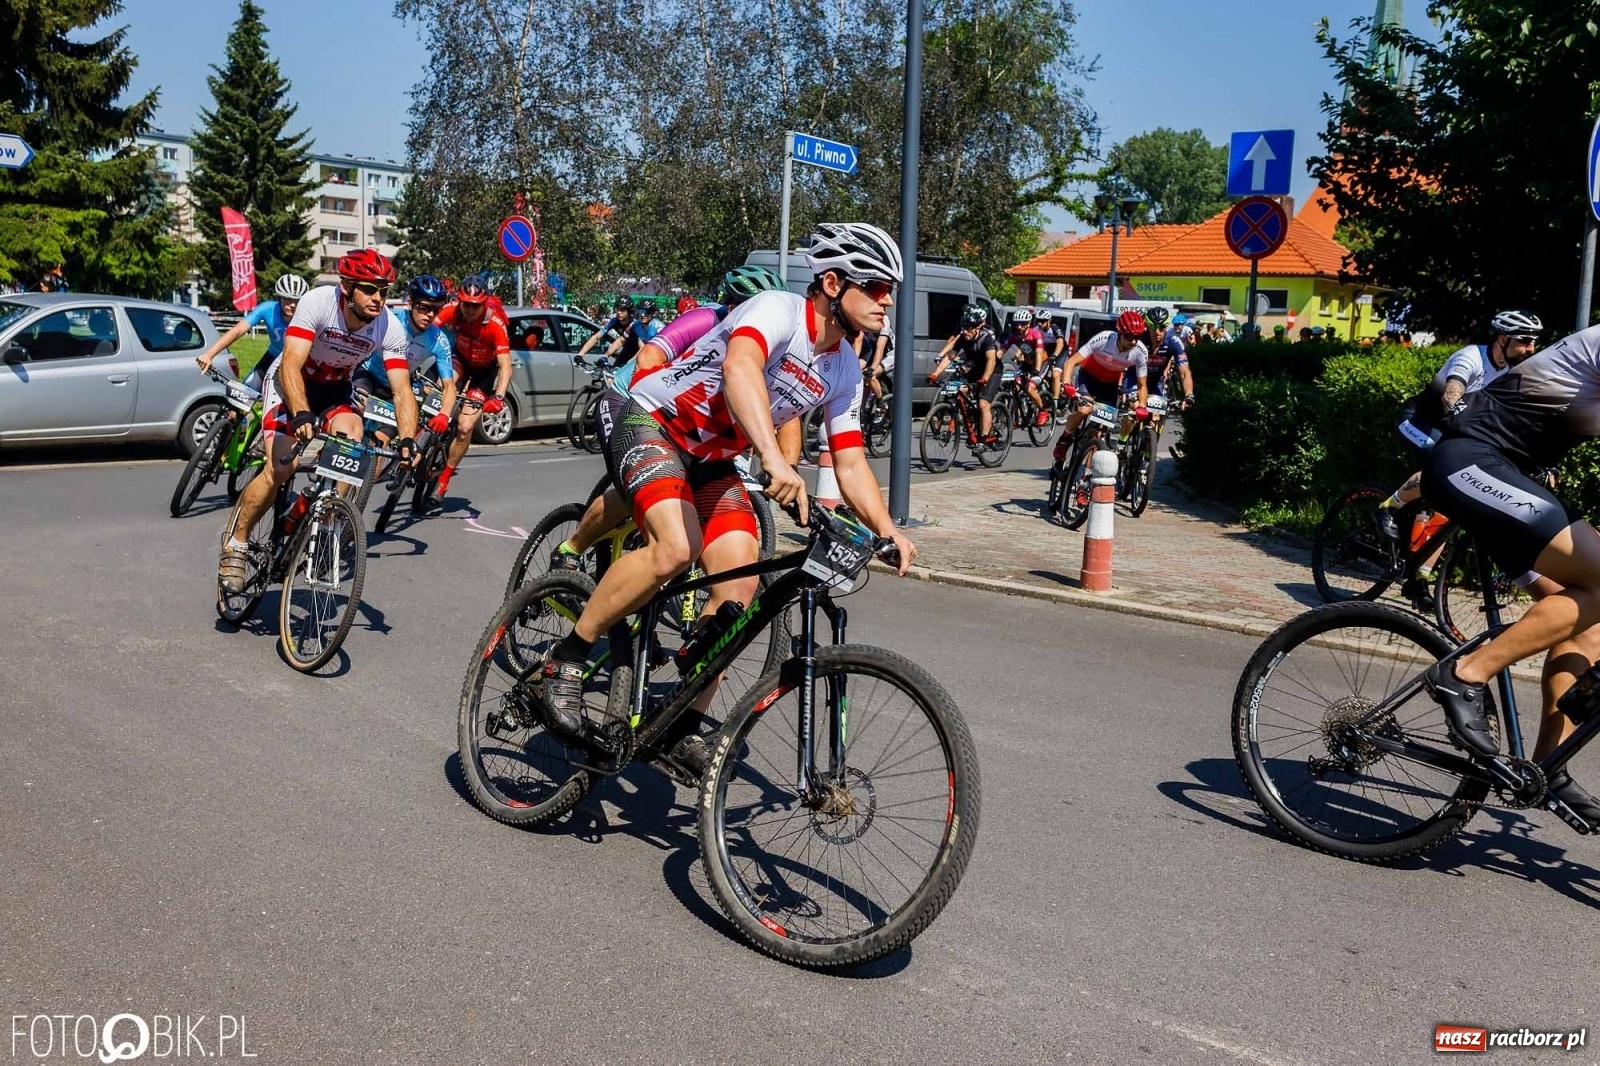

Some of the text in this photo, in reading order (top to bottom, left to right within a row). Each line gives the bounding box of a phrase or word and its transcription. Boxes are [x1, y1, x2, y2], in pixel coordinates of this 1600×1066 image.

[797, 140, 846, 165] ul. Piwna
[1137, 283, 1167, 292] SKUP
[780, 359, 825, 398] SPIDER
[331, 454, 360, 473] 1523
[703, 735, 730, 809] MAXXIS
